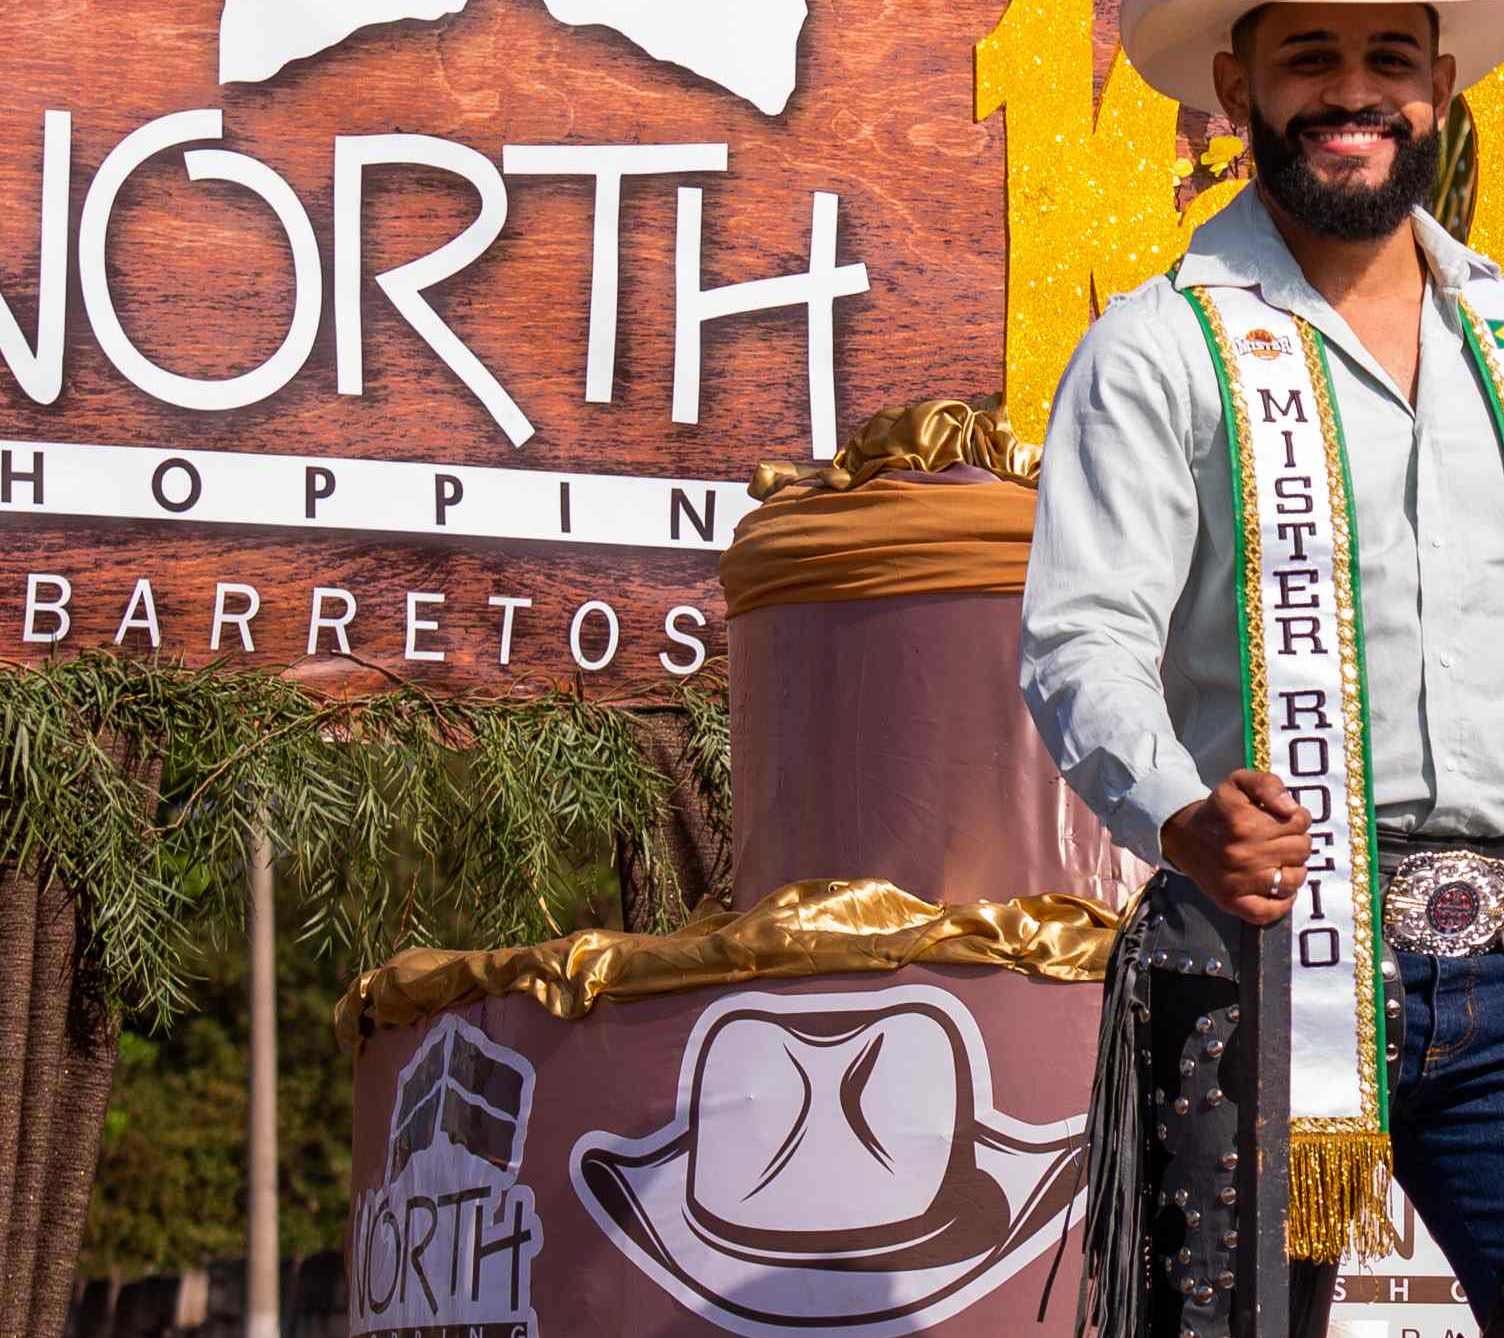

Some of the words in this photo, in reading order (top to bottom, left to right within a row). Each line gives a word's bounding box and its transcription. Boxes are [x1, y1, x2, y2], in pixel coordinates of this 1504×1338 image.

[1257, 388, 1328, 654] MISTER
[23, 574, 707, 675] BARRETOS
[355, 1185, 532, 1317] NORTH
